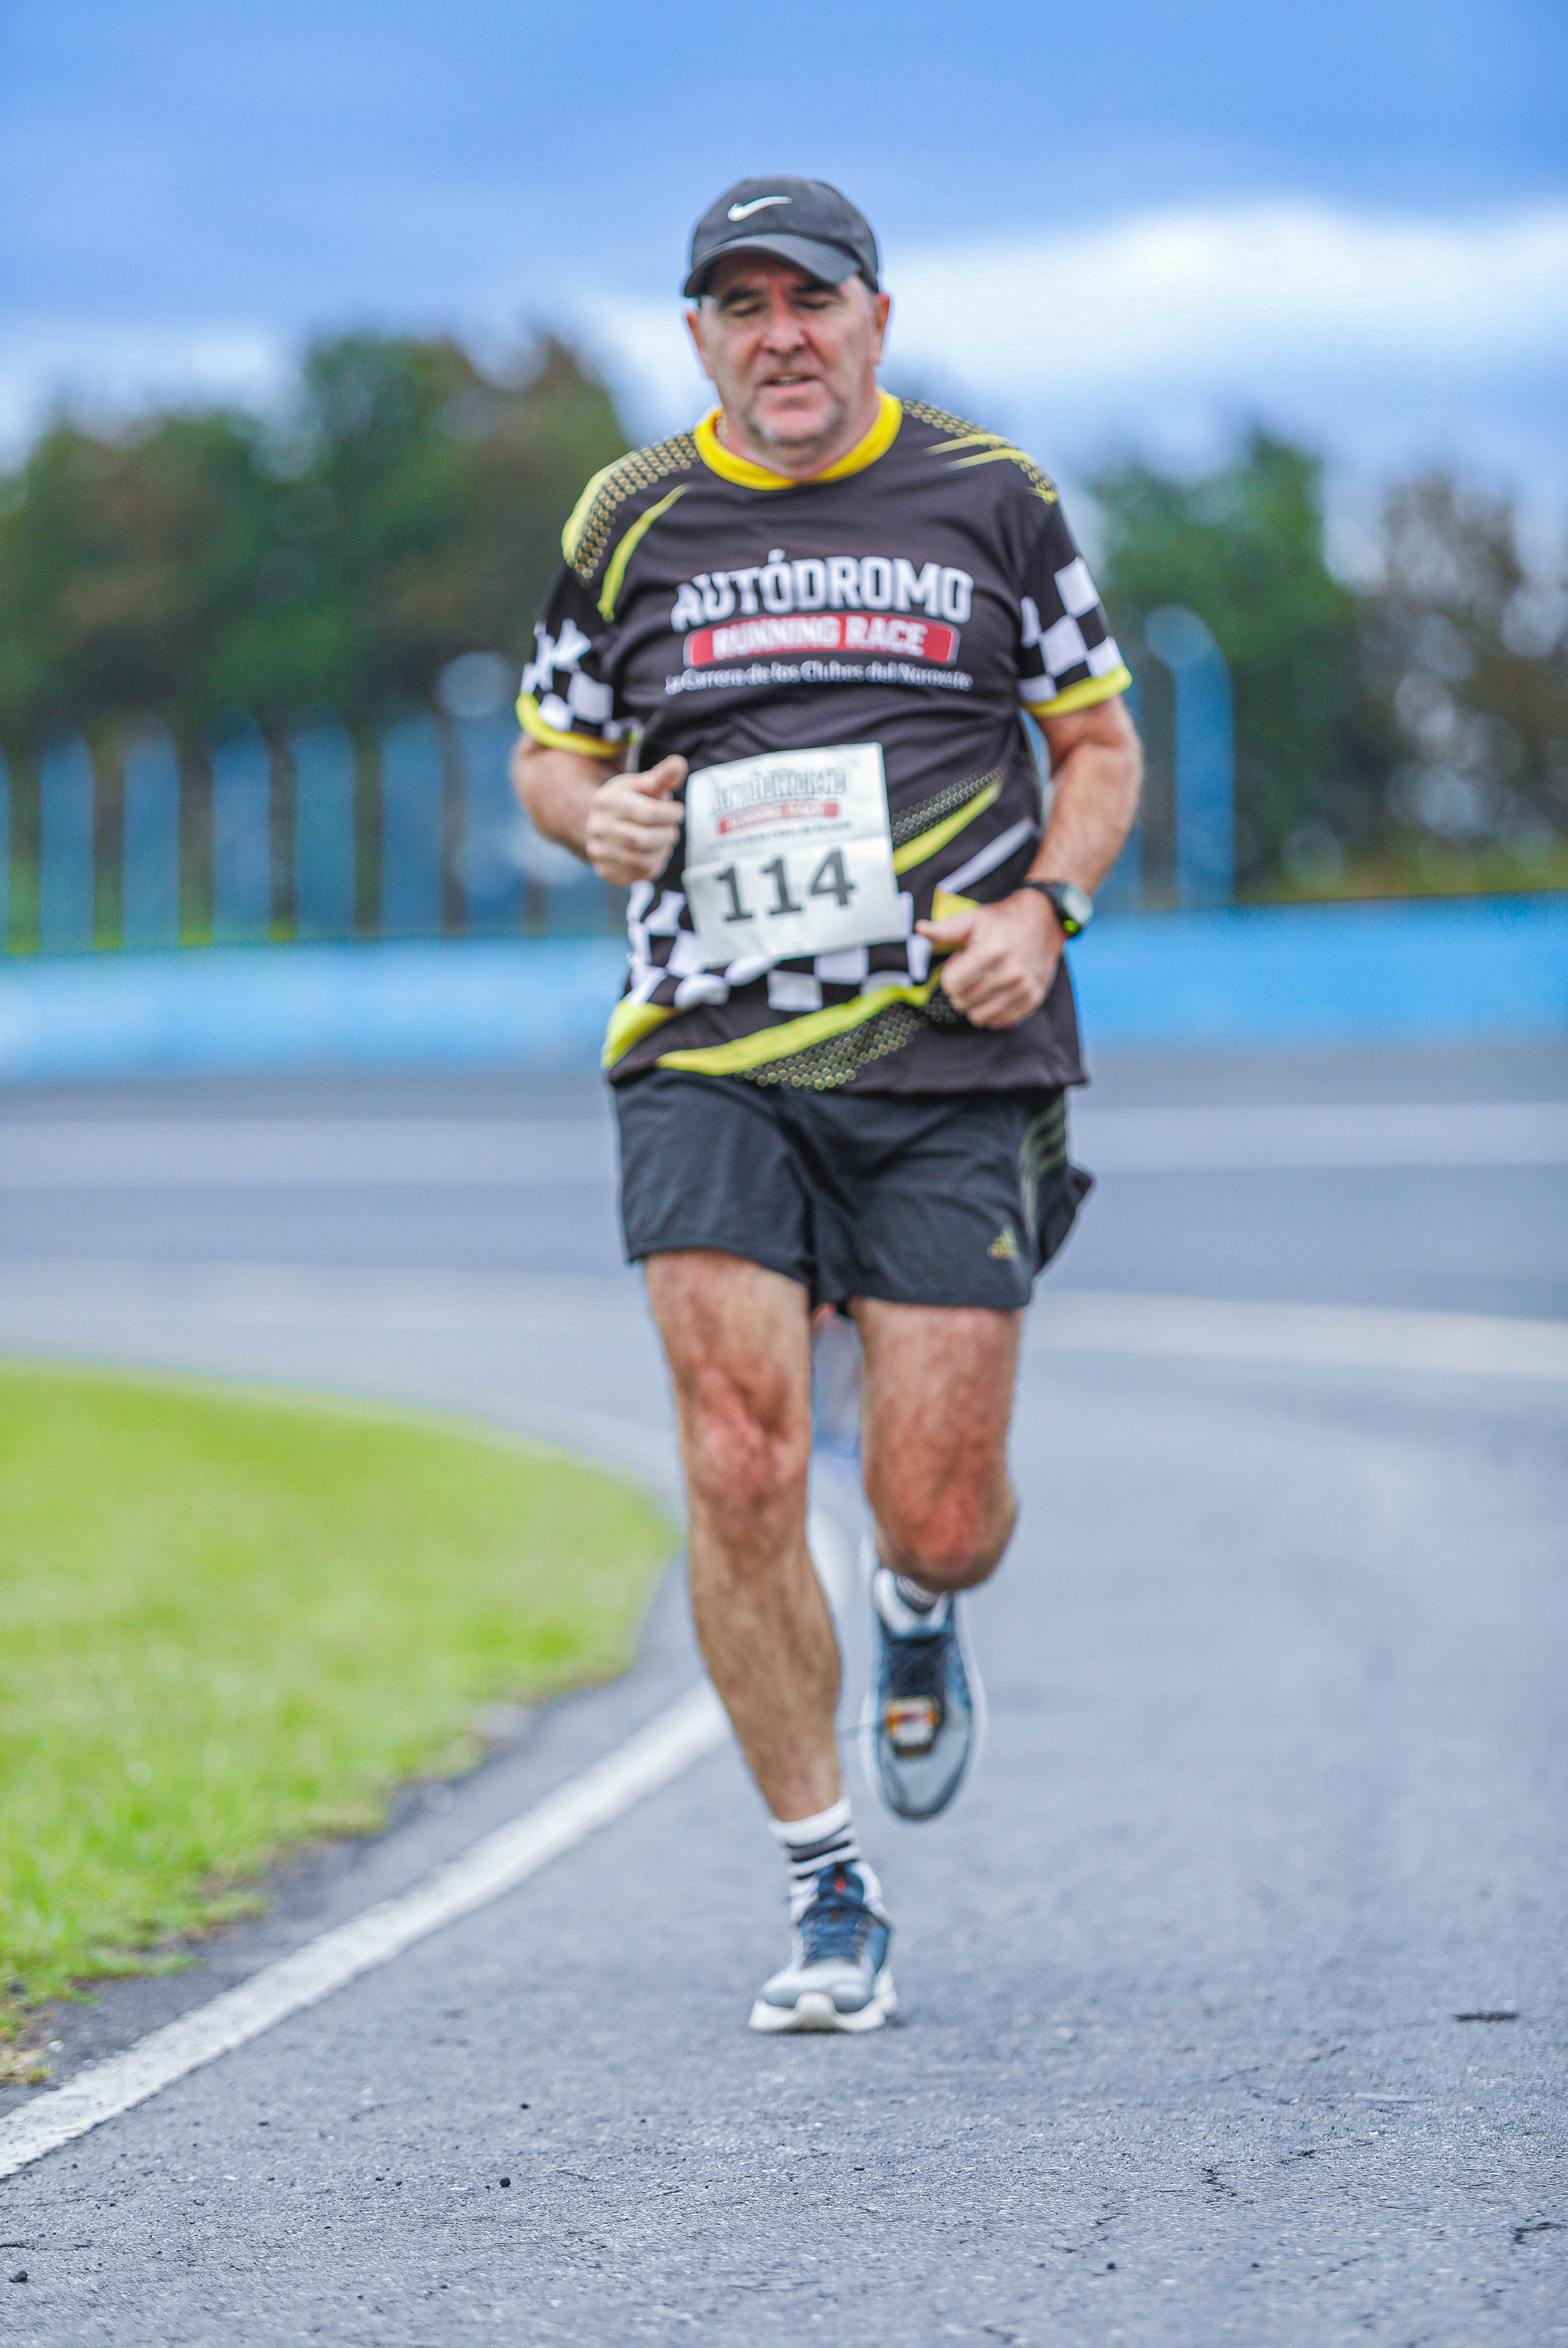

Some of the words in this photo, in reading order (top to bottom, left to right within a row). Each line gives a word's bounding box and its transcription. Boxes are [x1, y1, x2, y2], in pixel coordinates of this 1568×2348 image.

[671, 548, 973, 632] AUTÓDROMO
[712, 616, 842, 660] RUNNING
[844, 617, 928, 656] RACE
[716, 847, 855, 921] 114
